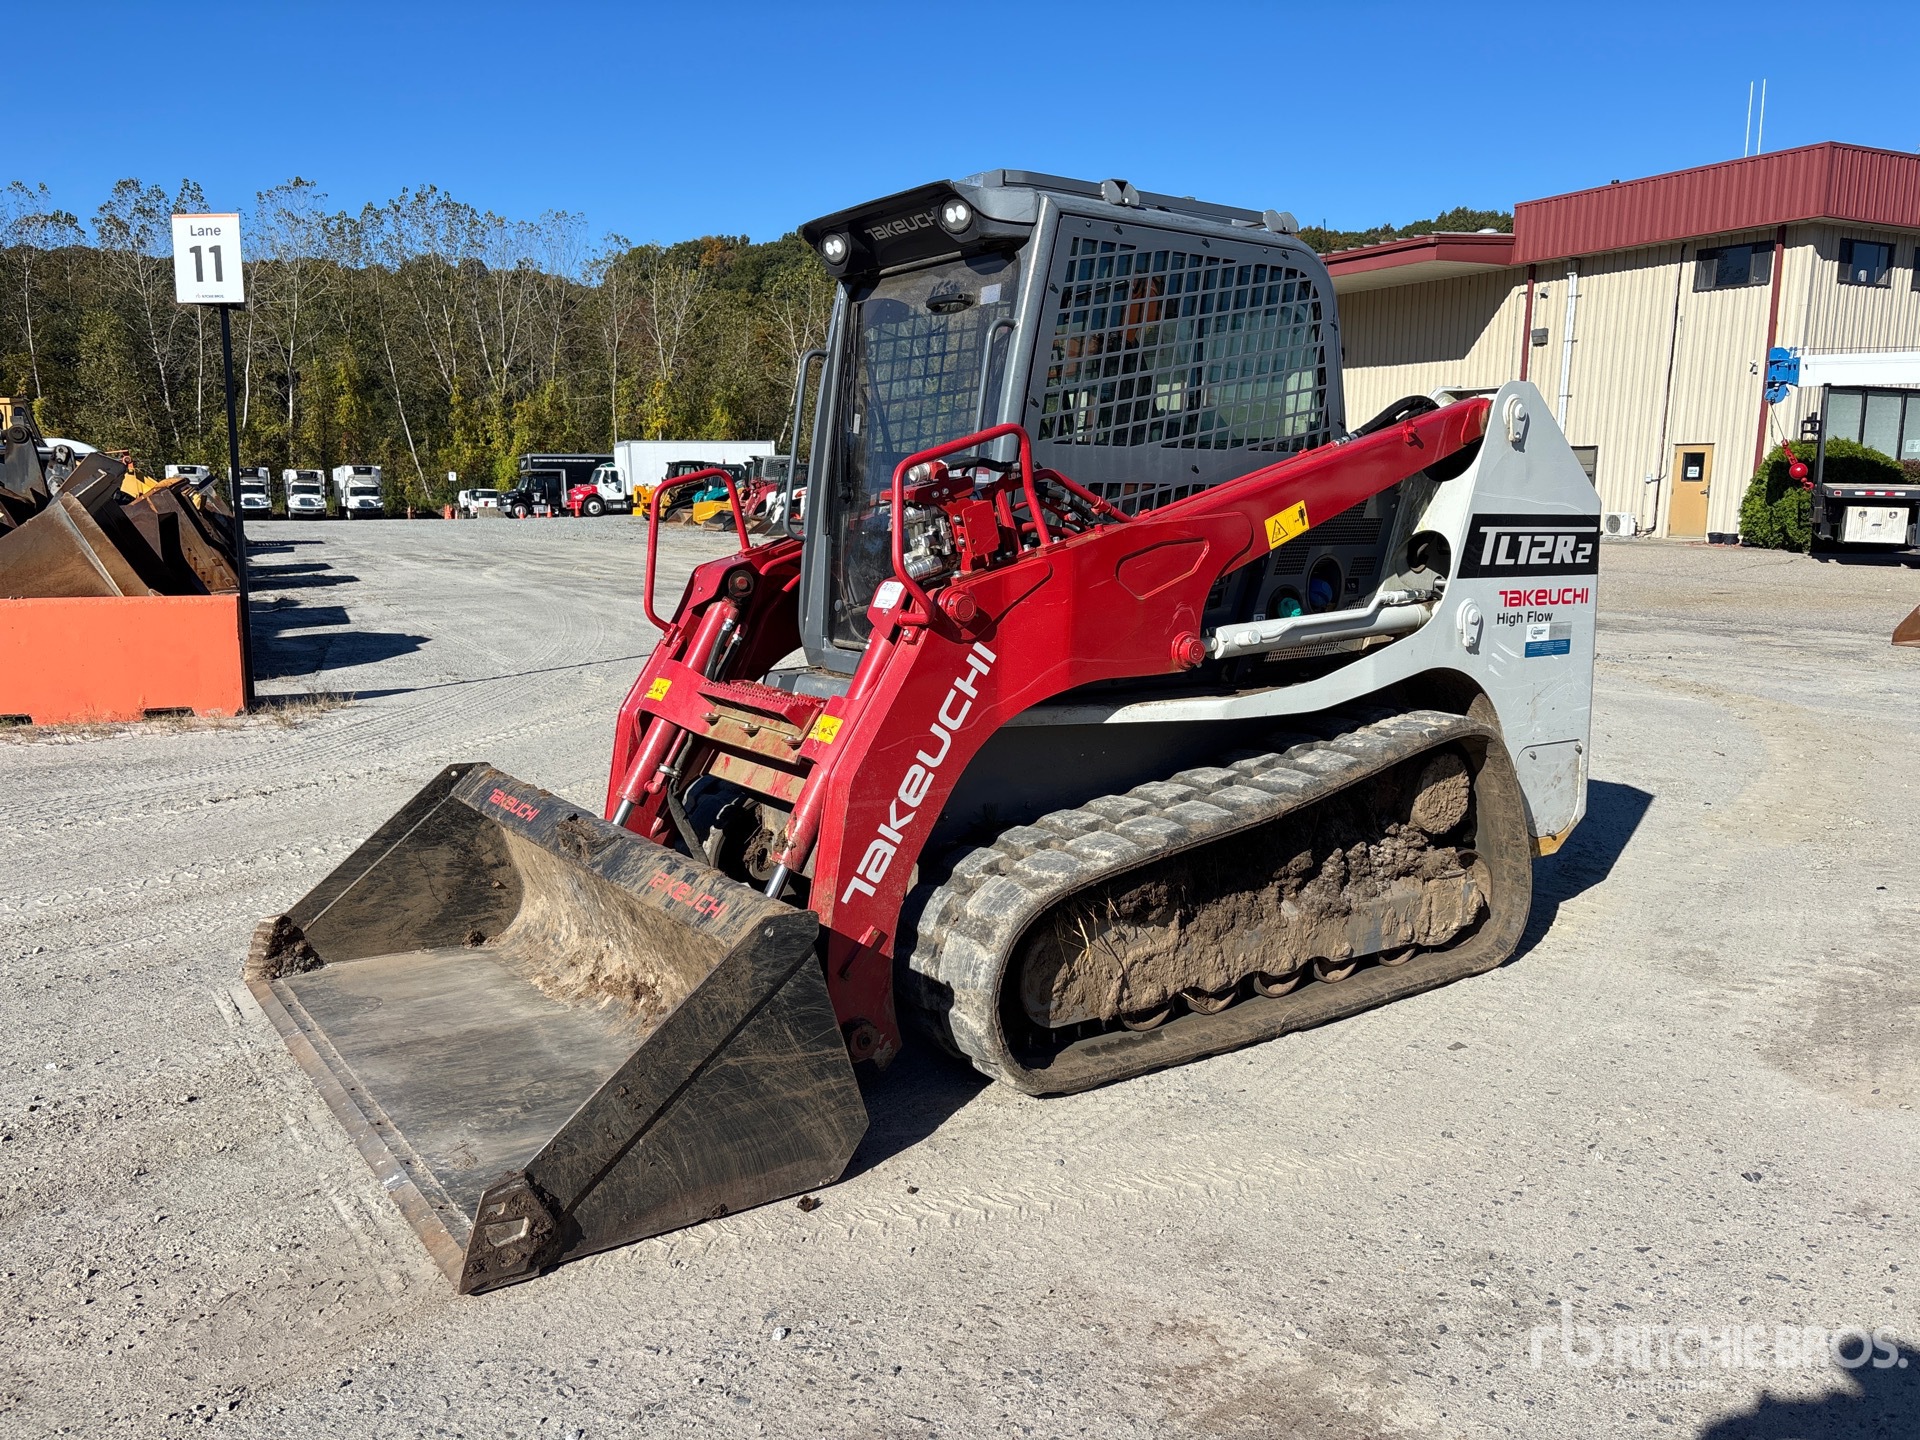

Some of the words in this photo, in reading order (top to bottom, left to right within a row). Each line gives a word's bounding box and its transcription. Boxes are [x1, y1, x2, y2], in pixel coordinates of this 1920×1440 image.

[190, 225, 221, 236] Lane
[864, 211, 936, 241] TAKEUCH
[189, 245, 223, 282] 11
[1479, 527, 1598, 566] TL12R2
[1499, 588, 1589, 607] TAKEUCHI
[1496, 612, 1523, 627] High
[1526, 611, 1553, 623] Flow
[841, 641, 997, 904] TAKEUCHI
[489, 788, 540, 822] TAKEUCHI
